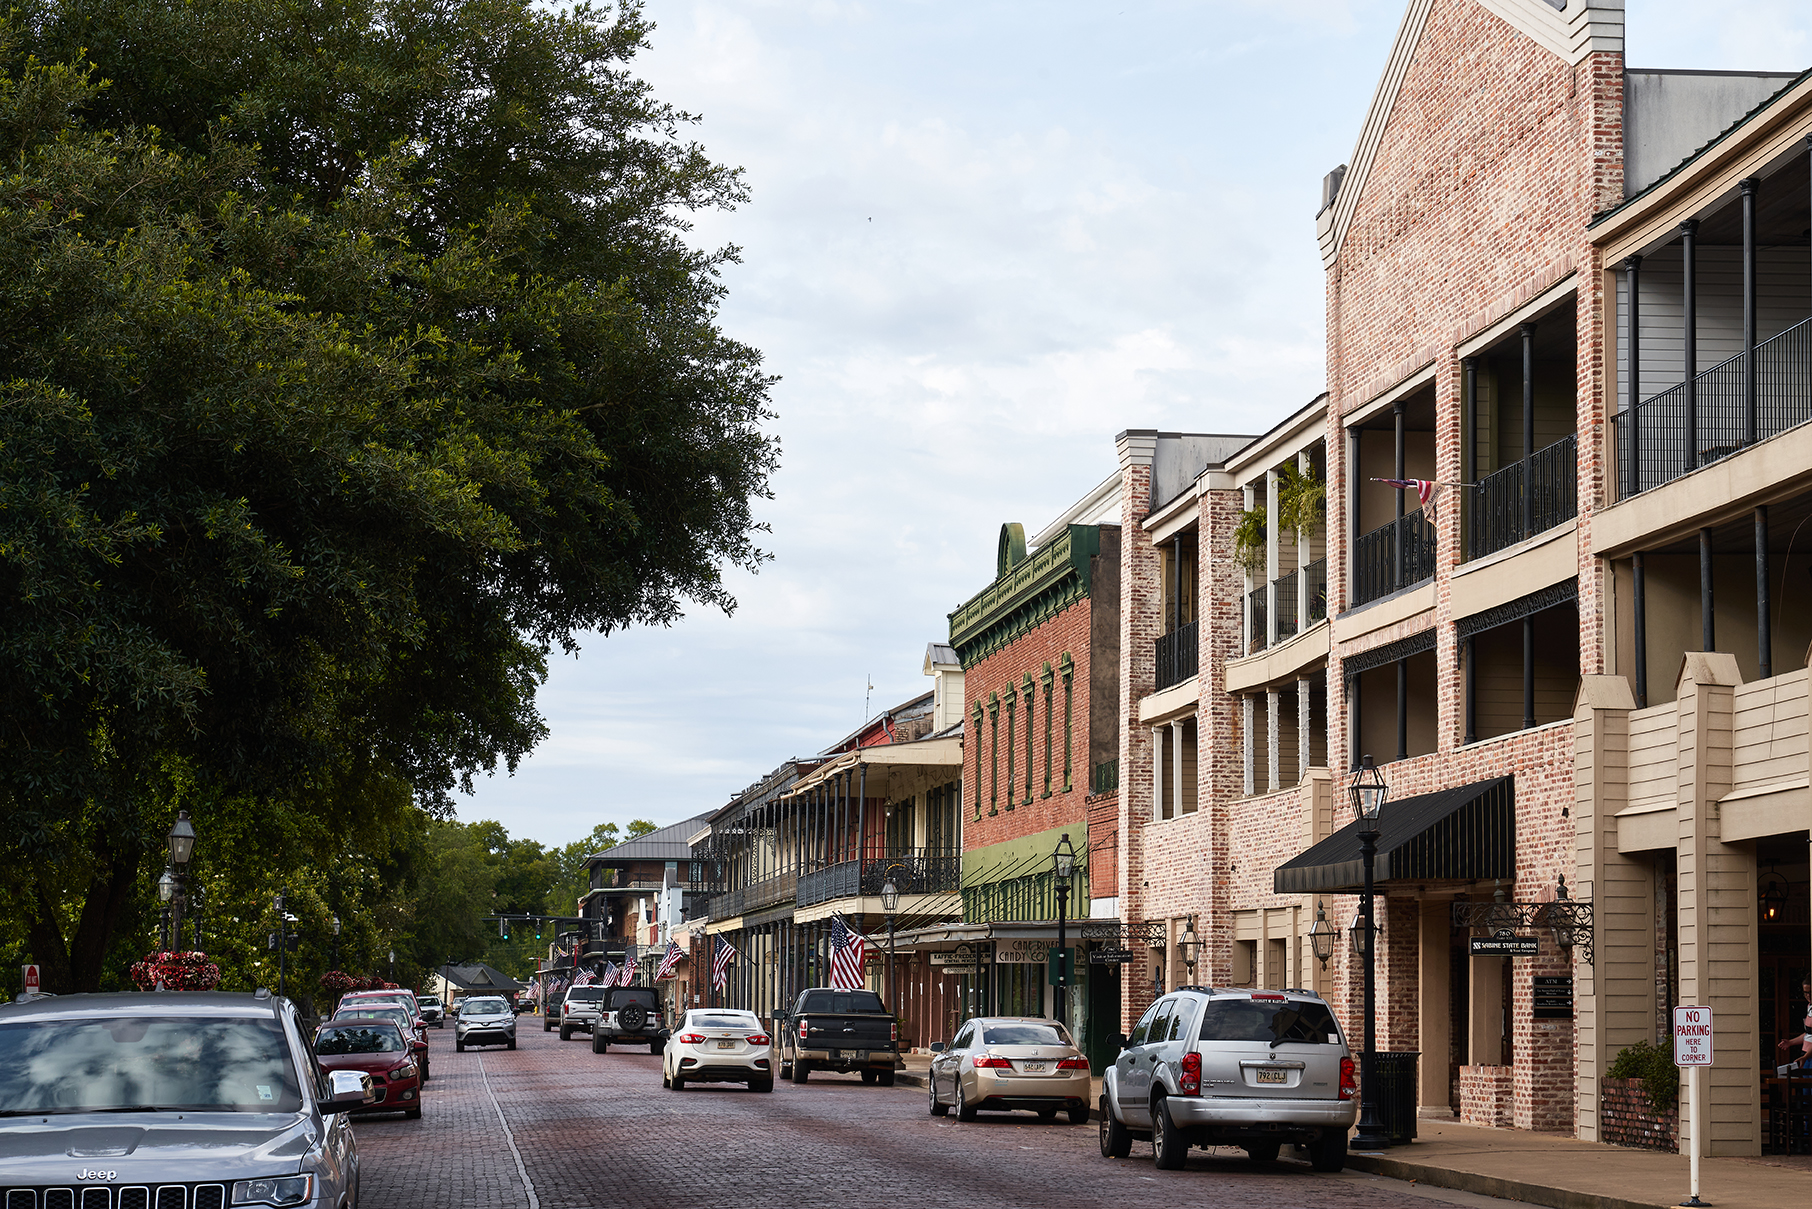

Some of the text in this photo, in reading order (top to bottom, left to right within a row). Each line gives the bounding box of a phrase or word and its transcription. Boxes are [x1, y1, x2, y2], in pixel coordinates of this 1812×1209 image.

[1012, 940, 1032, 951] CANE
[998, 951, 1026, 962] CANDY
[1686, 1011, 1700, 1022] NO
[1677, 1025, 1710, 1036] PARKING
[1681, 1054, 1706, 1062] CORNER
[1259, 1071, 1286, 1080] 792 CLJ
[76, 1168, 118, 1182] Jeep
